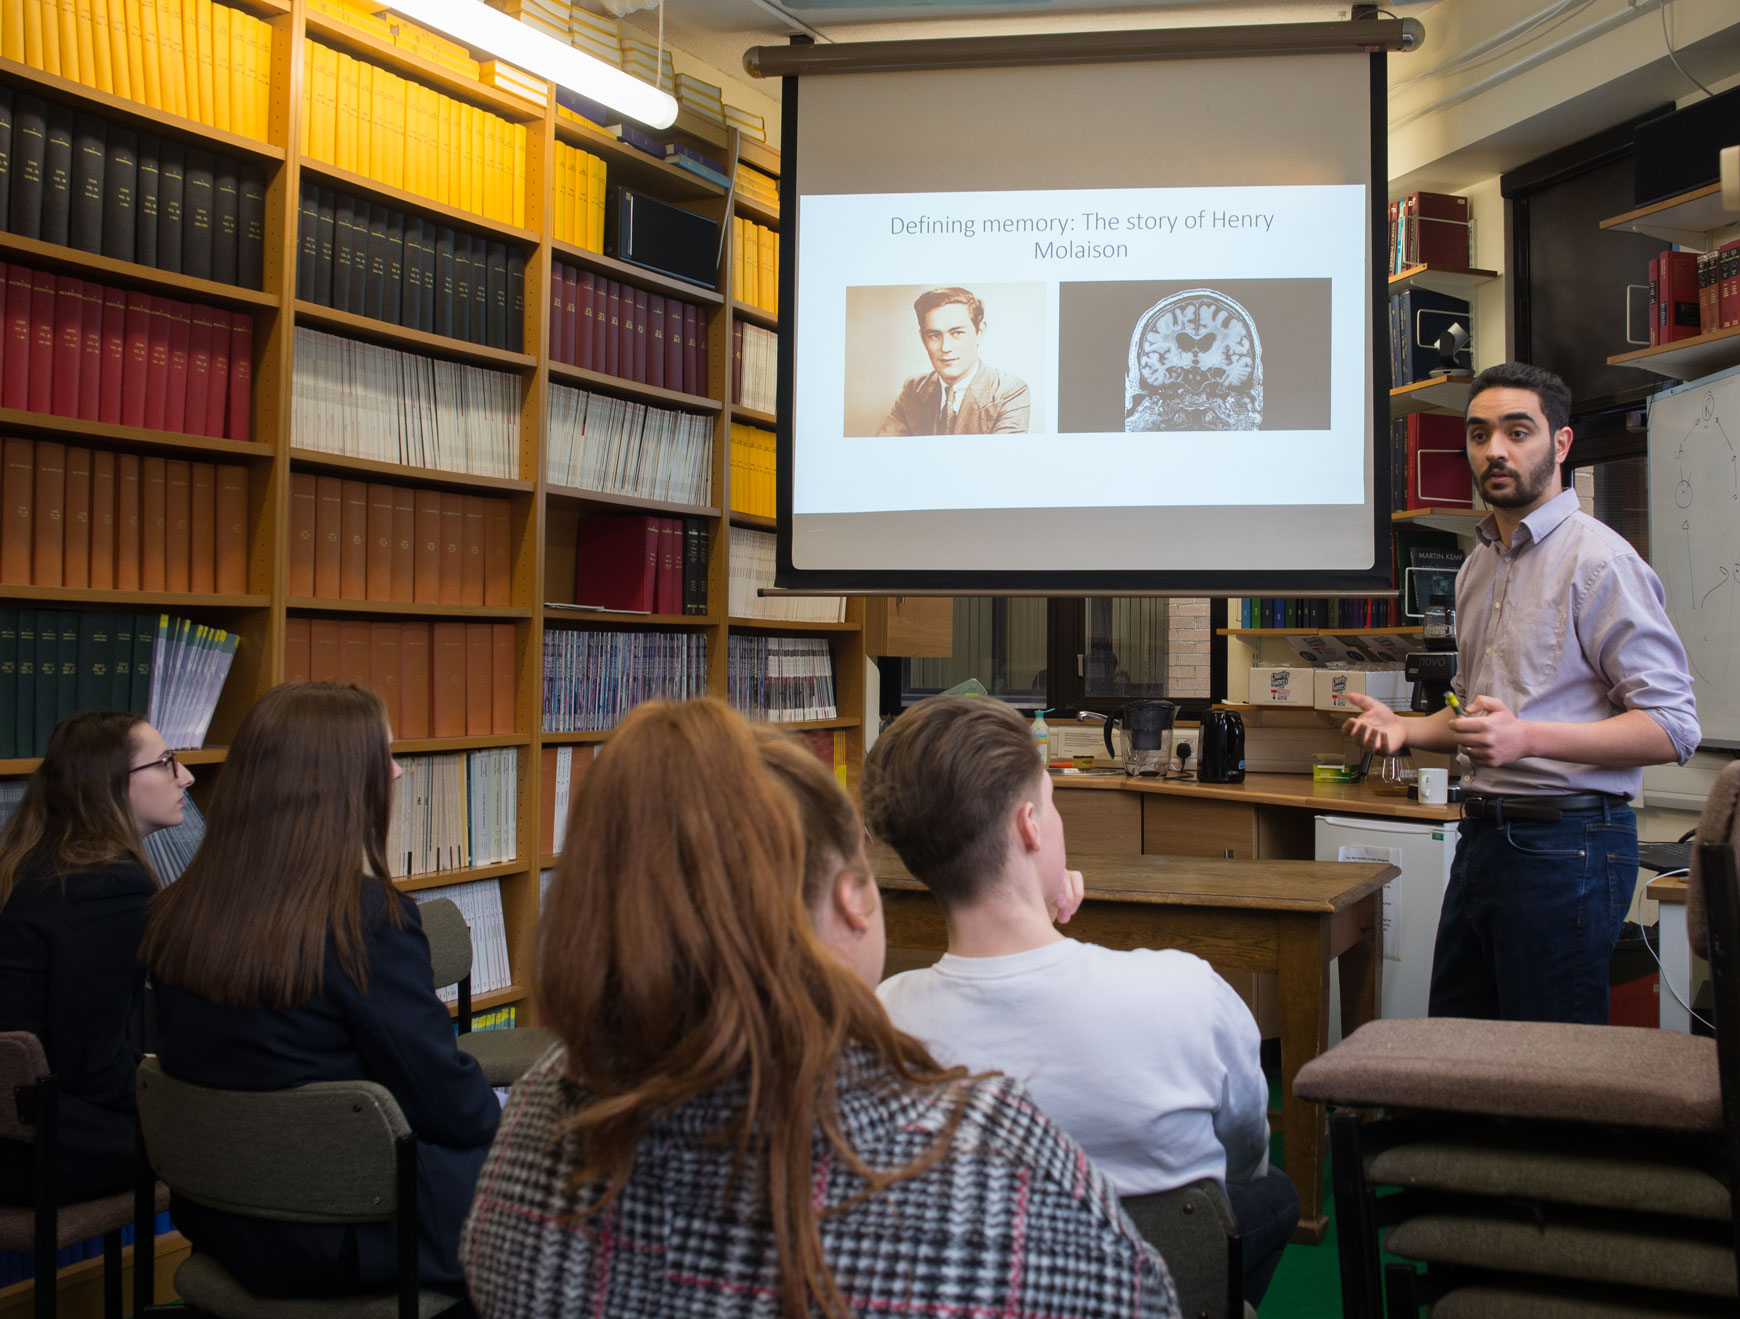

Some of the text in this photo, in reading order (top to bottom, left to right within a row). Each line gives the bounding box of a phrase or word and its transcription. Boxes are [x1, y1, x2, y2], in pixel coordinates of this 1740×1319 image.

[891, 209, 1275, 238] Defining memory: The story of Henry
[1034, 239, 1128, 260] Molaison
[1418, 552, 1464, 561] MARTIN KEMP
[1418, 656, 1447, 668] novo
